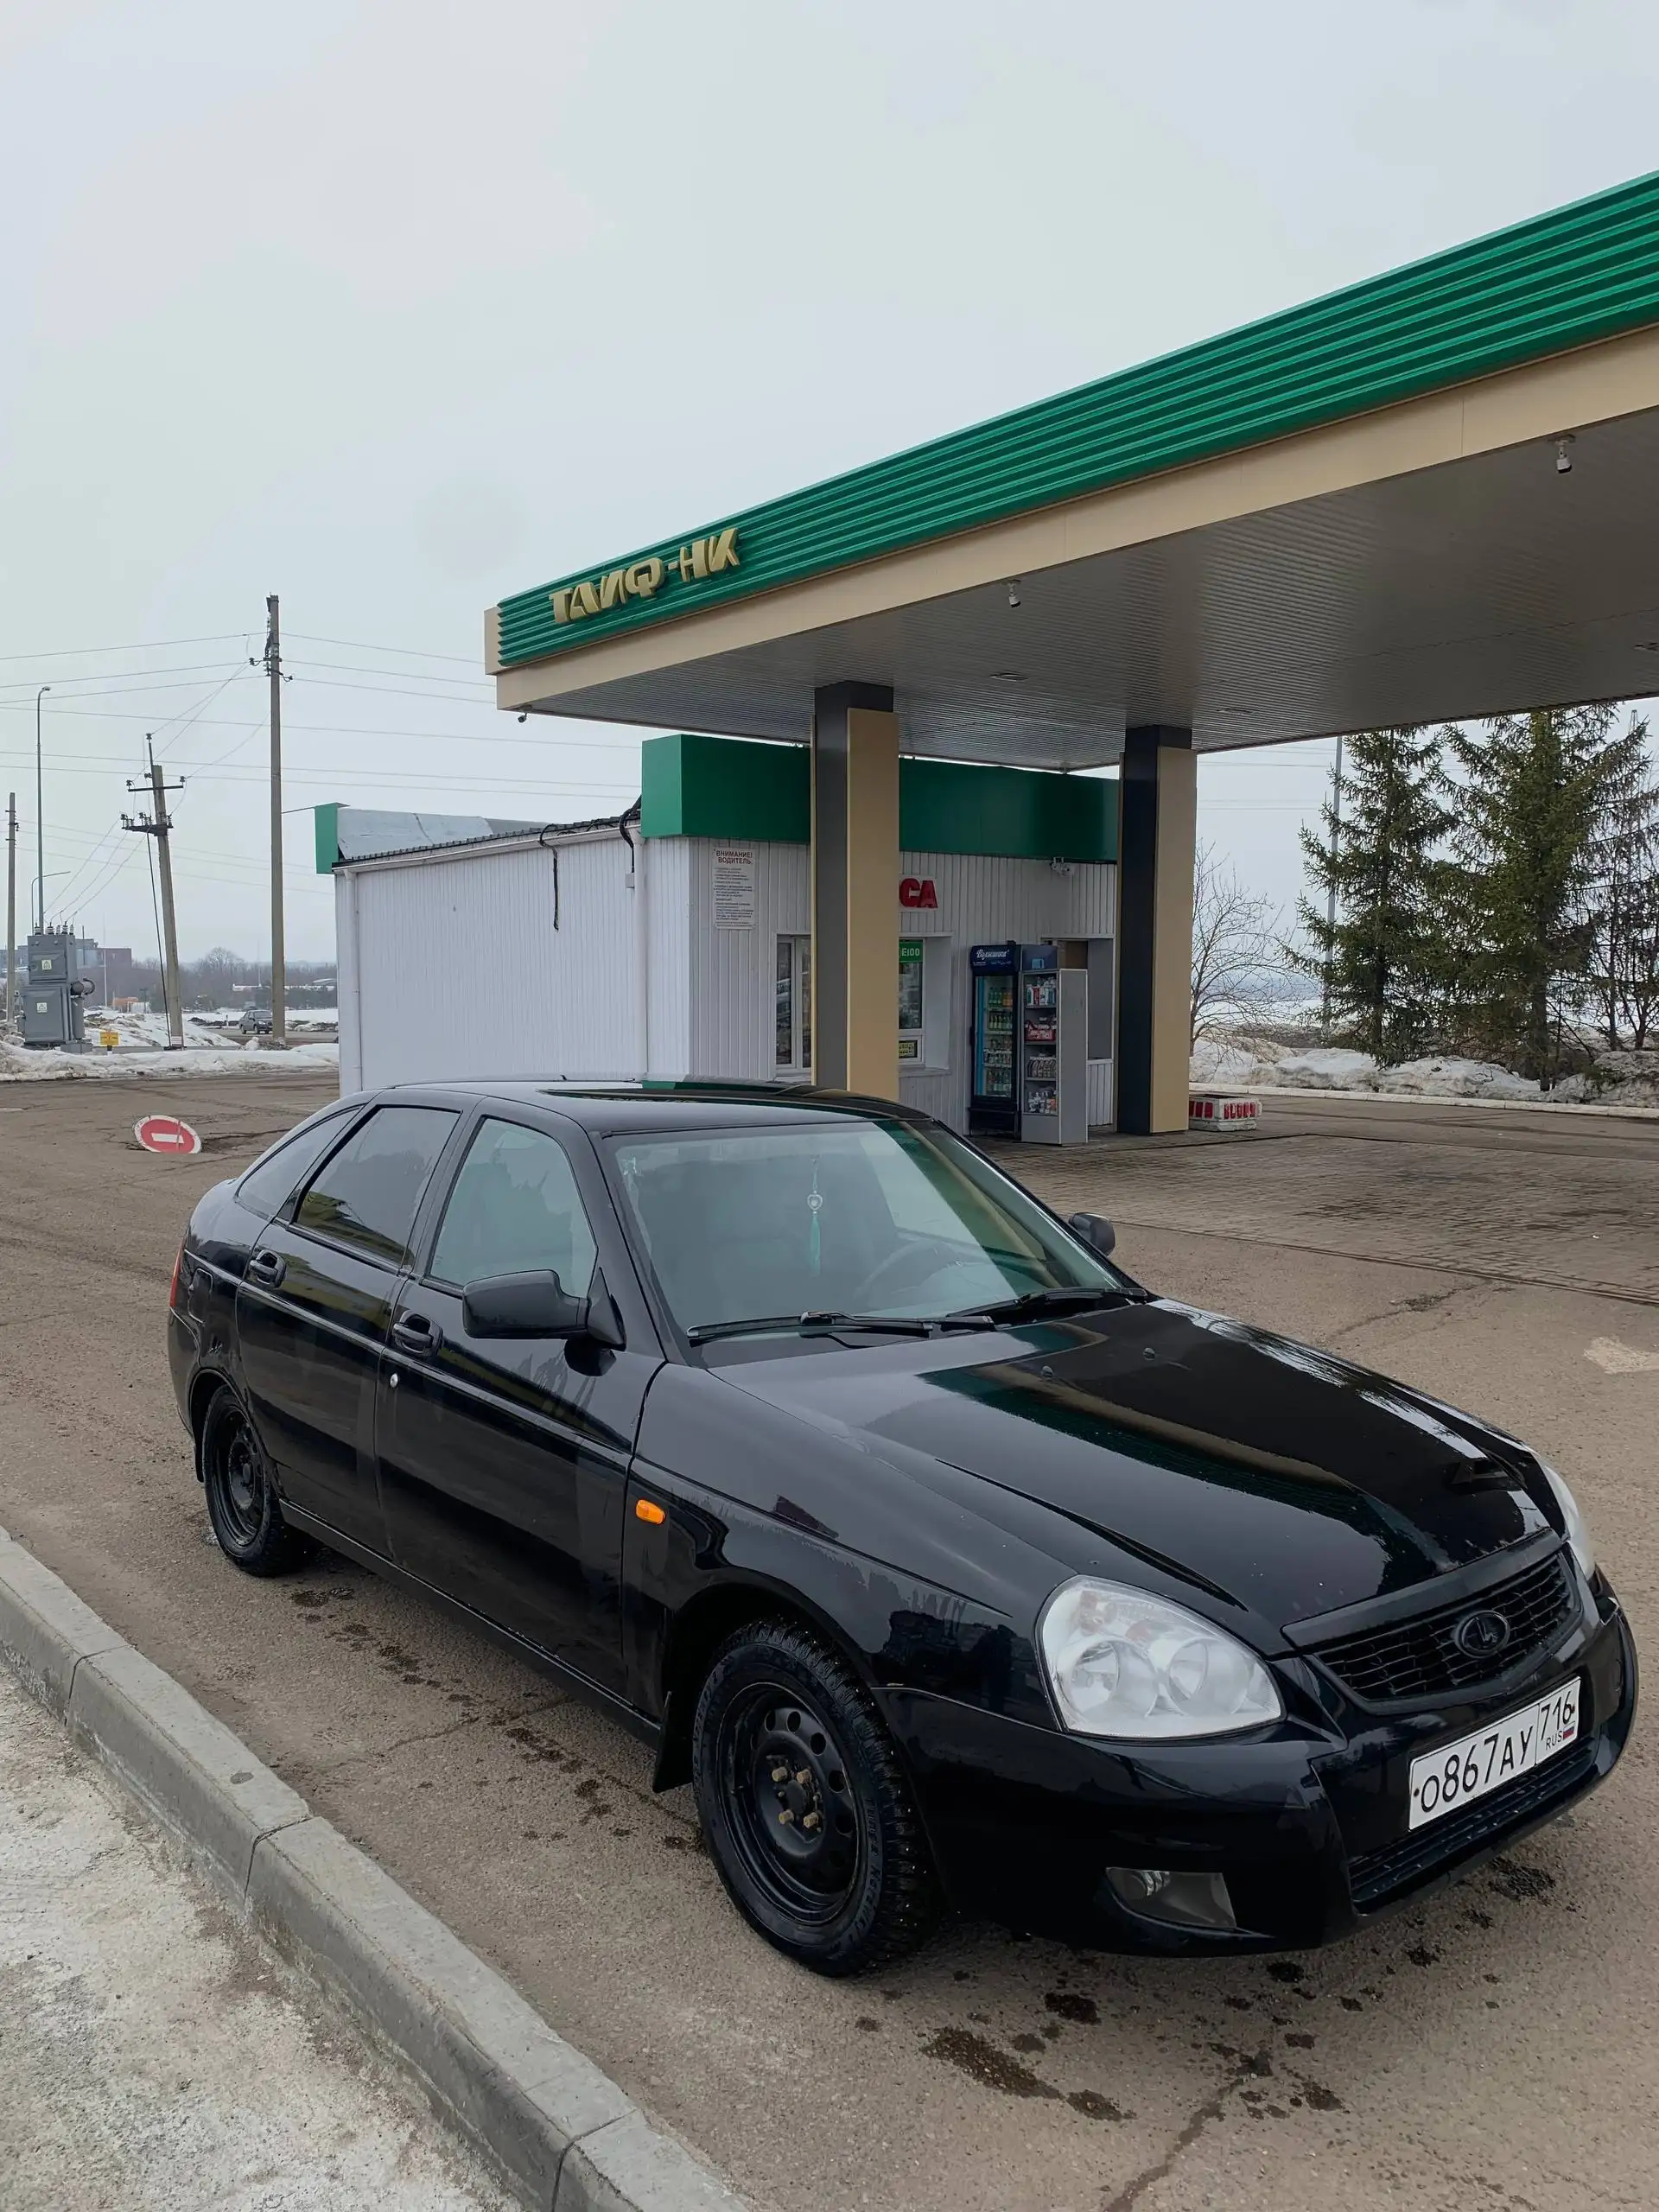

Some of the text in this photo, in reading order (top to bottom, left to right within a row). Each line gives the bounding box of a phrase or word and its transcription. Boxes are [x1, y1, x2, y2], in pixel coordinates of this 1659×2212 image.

[549, 526, 741, 624] ТАИФ-НК
[899, 877, 938, 909] СА
[1541, 1691, 1573, 1741] 716
[1546, 1730, 1563, 1751] RUS
